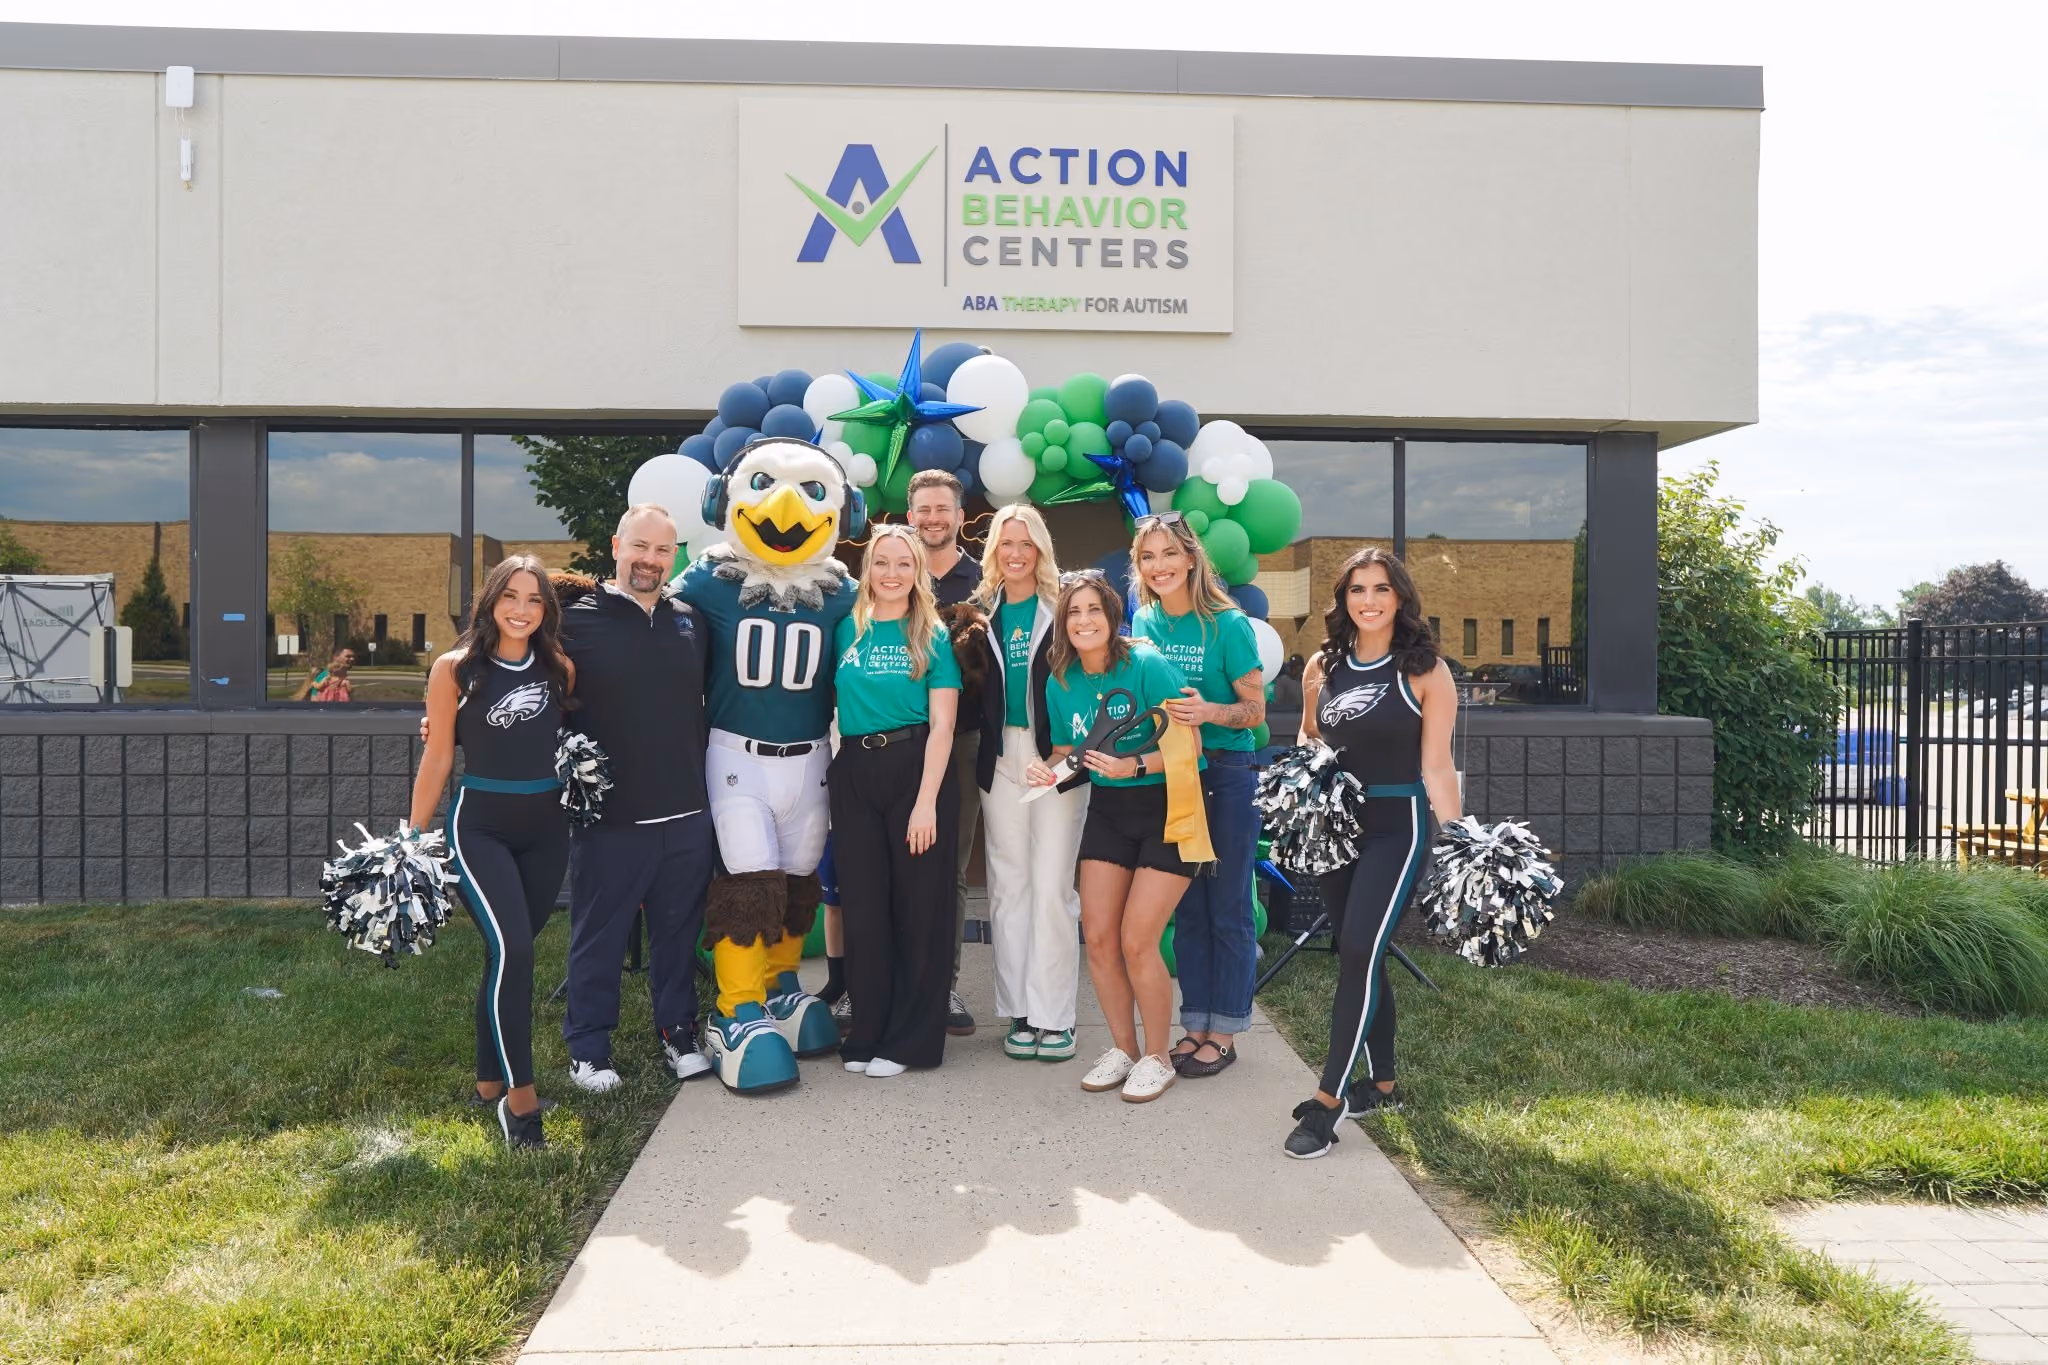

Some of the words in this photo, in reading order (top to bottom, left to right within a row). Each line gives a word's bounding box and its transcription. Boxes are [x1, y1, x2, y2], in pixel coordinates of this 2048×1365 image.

[964, 146, 1188, 188] ACTION
[962, 194, 1188, 229] BEHAVIOR
[963, 236, 1189, 269] CENTERS
[963, 295, 998, 311] ABA
[1002, 296, 1081, 313] THERAPY
[1085, 298, 1118, 313] FOR
[1123, 298, 1188, 314] AUTISM
[735, 617, 822, 691] 00
[871, 645, 908, 654] ACTIO
[1165, 644, 1205, 654] ACTION
[868, 661, 914, 669] CENTERS
[1179, 663, 1204, 672] TERS
